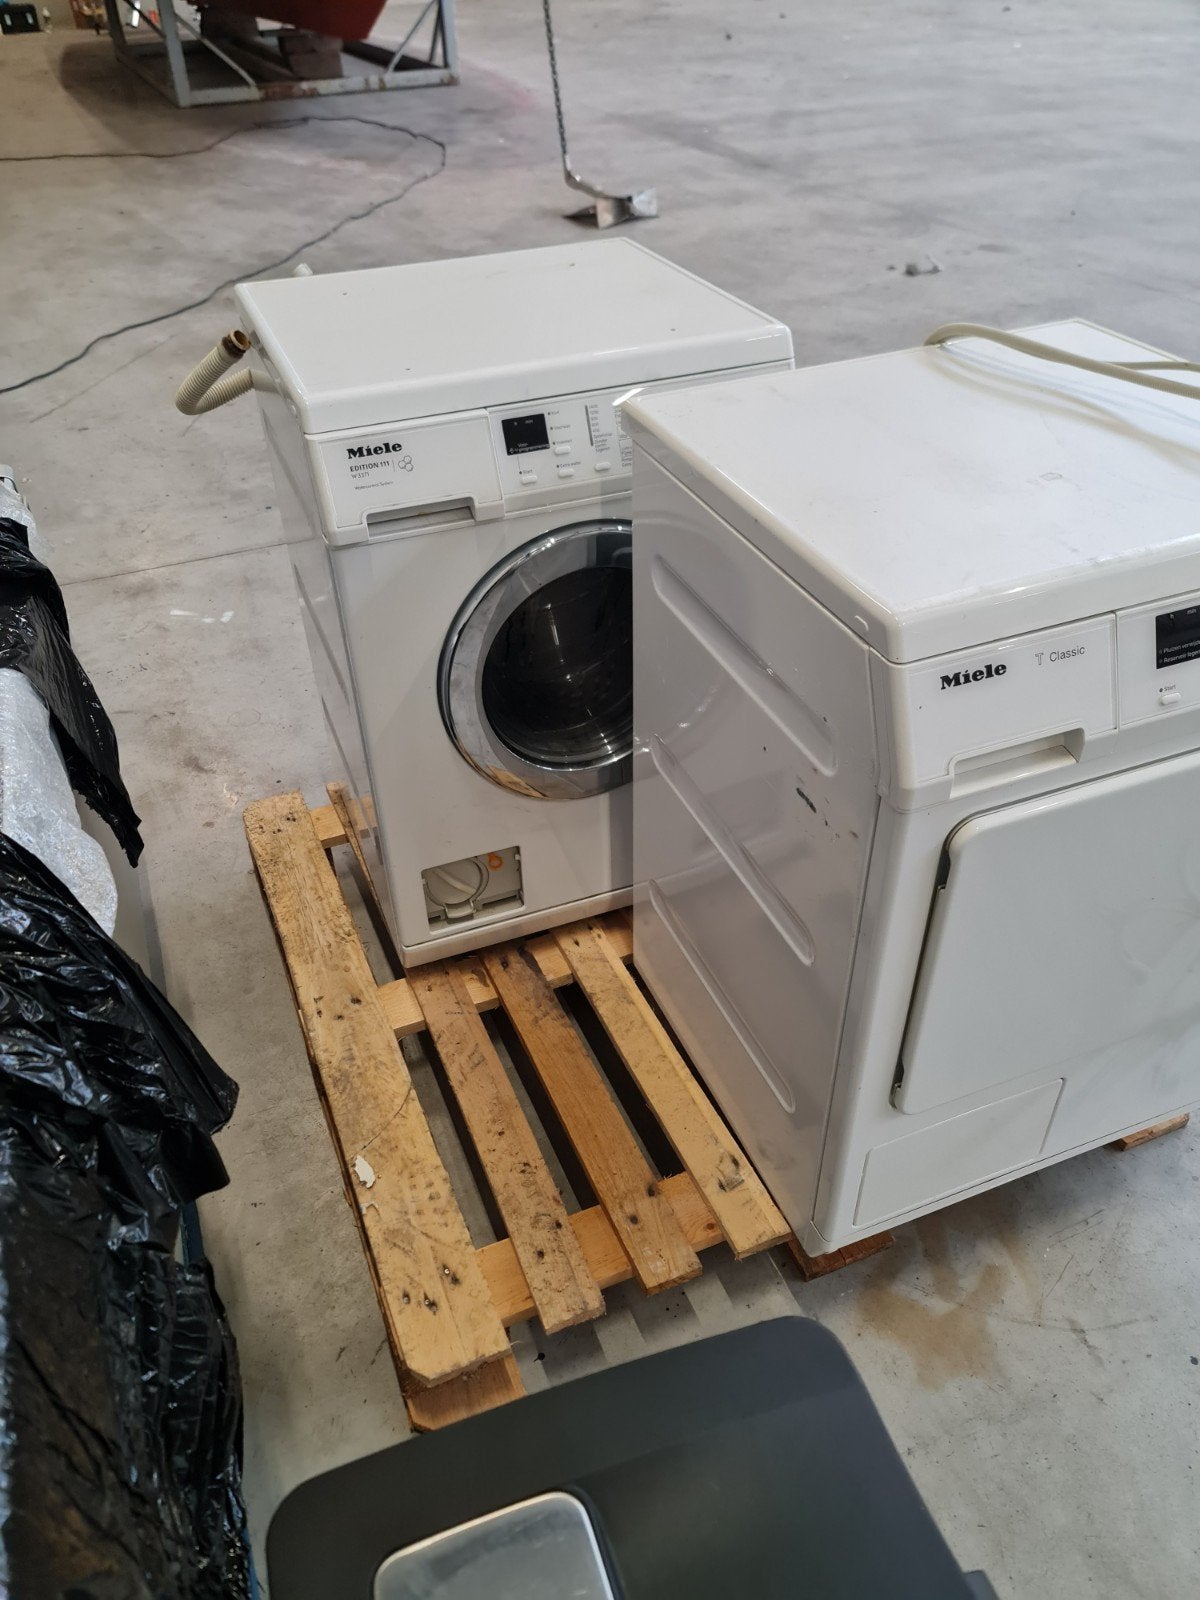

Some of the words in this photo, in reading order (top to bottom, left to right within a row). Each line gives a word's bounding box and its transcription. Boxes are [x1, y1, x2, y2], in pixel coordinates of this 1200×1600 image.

[346, 442, 402, 459] Miele
[350, 462, 379, 472] EDITION
[1049, 645, 1086, 662] Classic
[940, 663, 1007, 690] Miele
